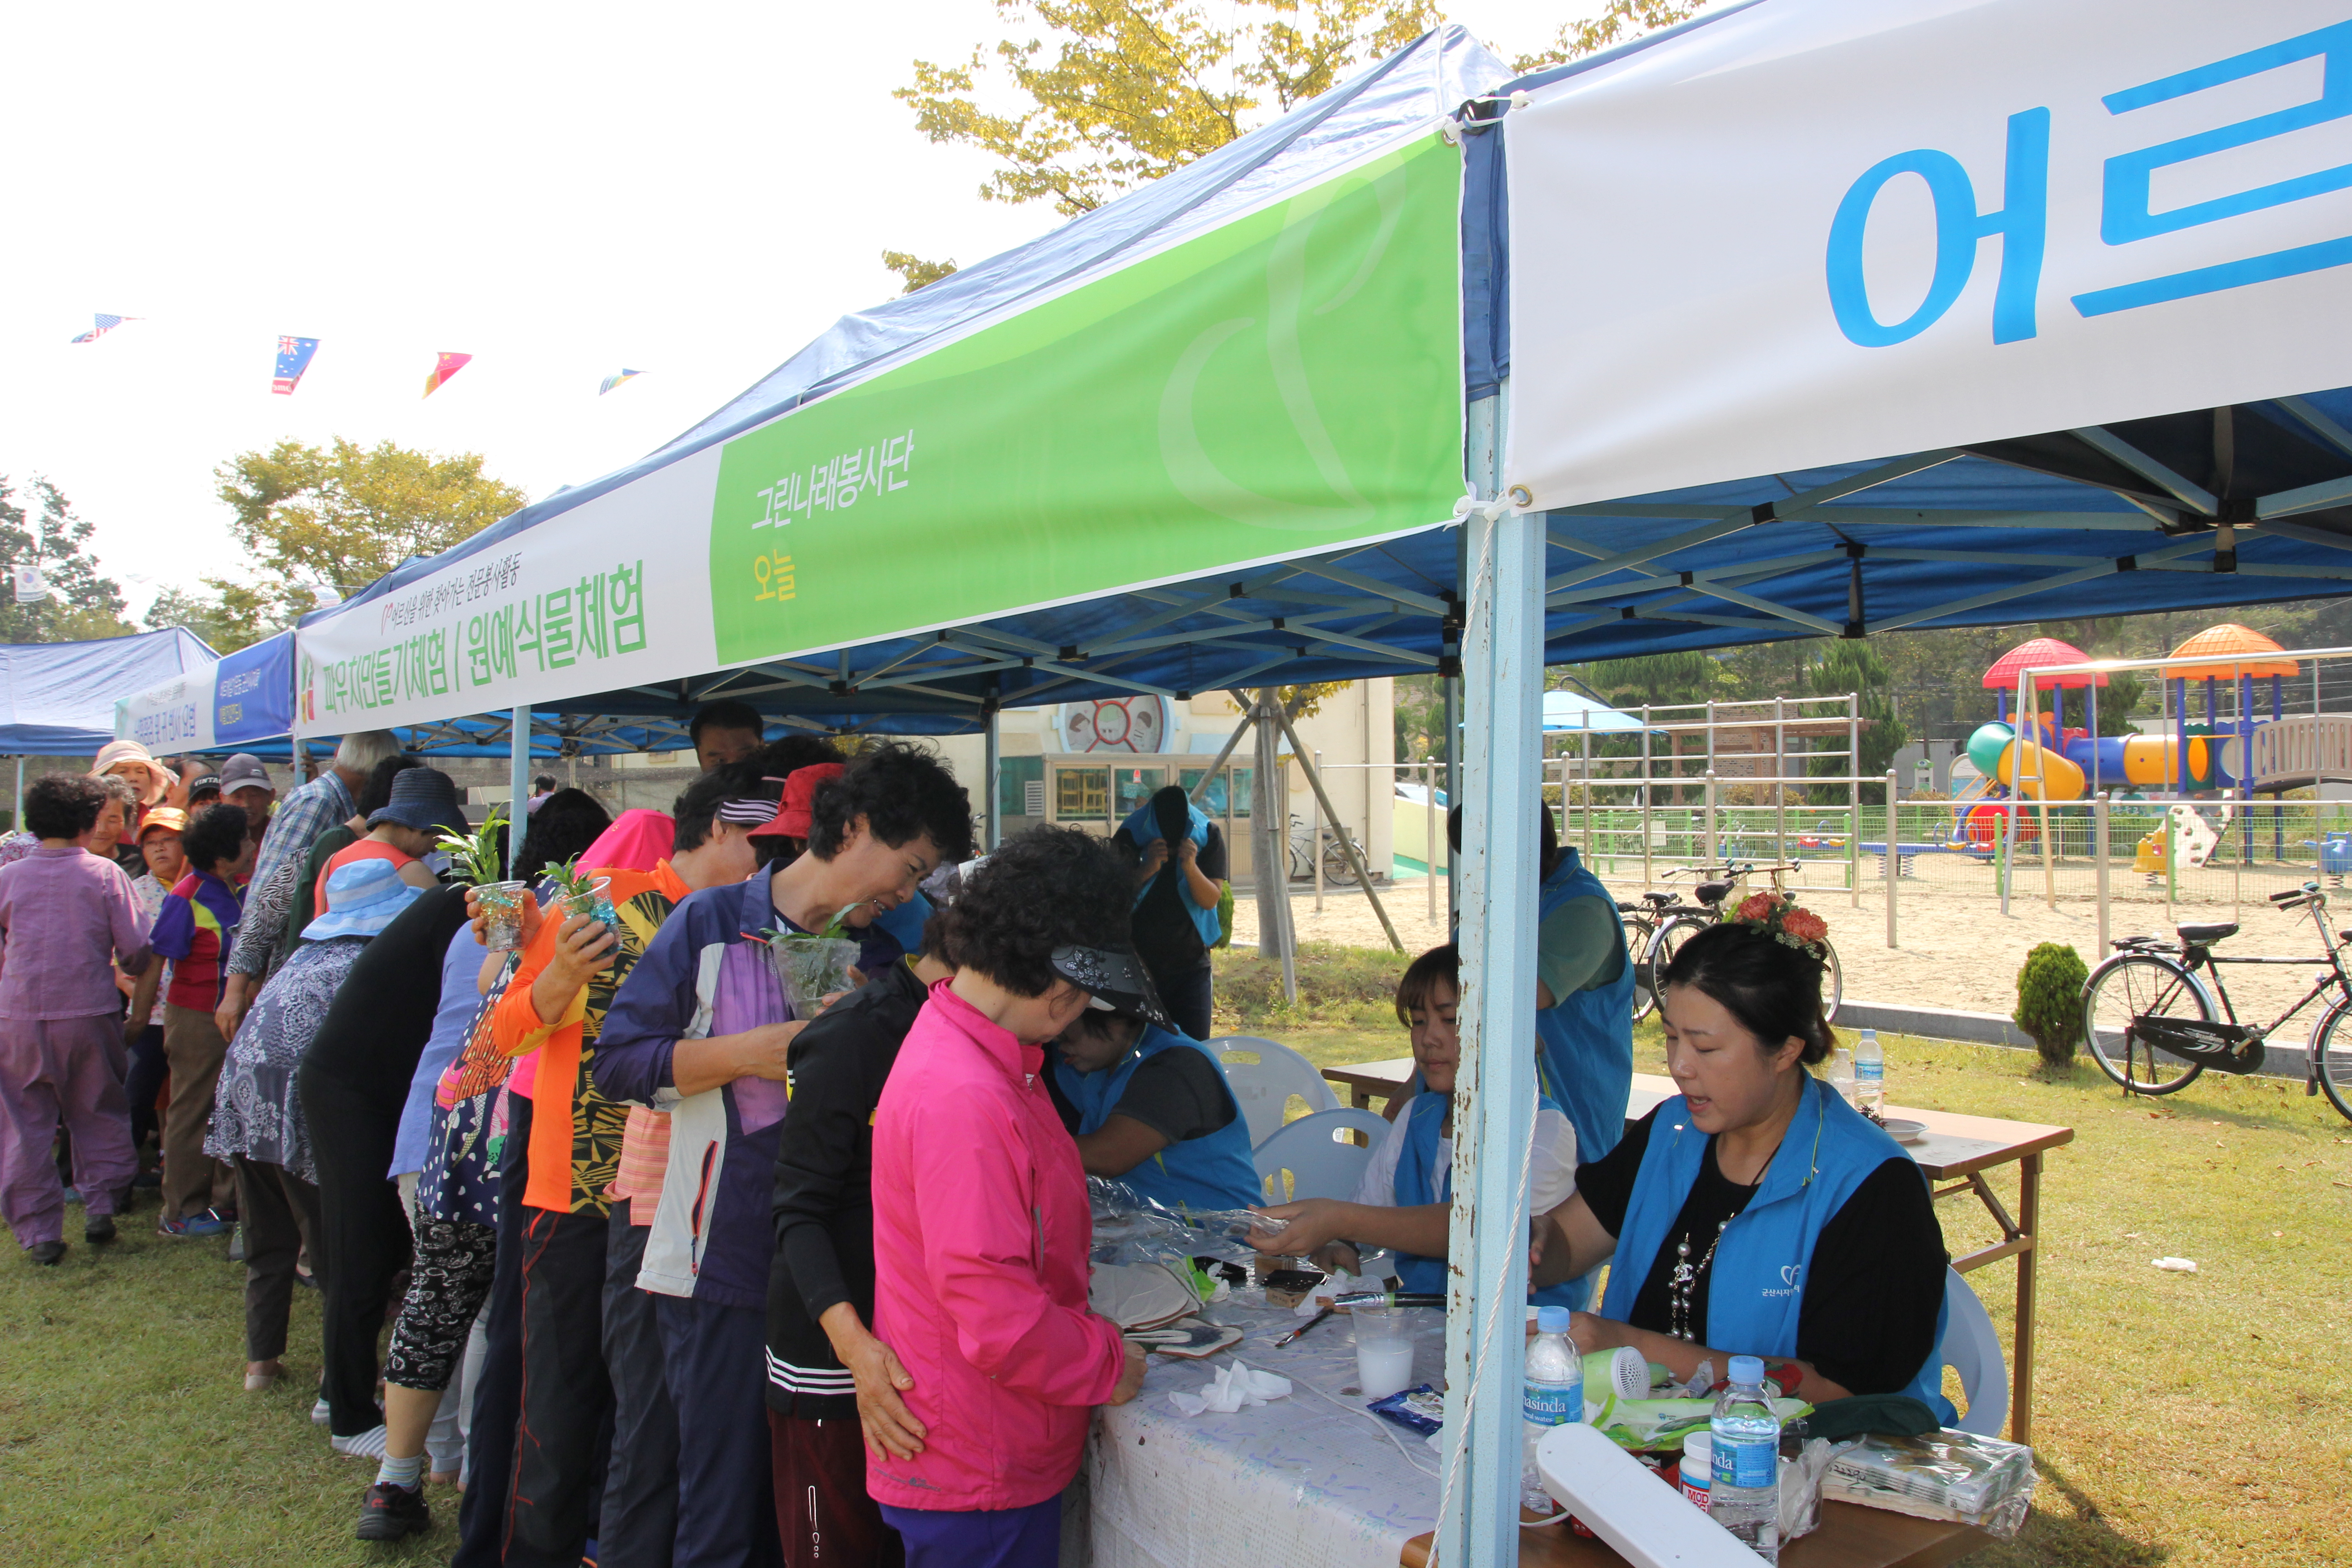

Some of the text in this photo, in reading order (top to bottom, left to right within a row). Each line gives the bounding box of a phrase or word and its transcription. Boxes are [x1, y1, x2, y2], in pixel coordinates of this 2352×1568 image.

[752, 429, 915, 529] 그린나래봉사단
[393, 552, 521, 627] 어르신을 위한 찾아가는 전문봉사활동
[754, 549, 796, 602] 오늘
[323, 627, 448, 714] 파우치만들기체험
[468, 560, 647, 686] 원예식물체험
[1688, 1489, 1709, 1504] MOD
